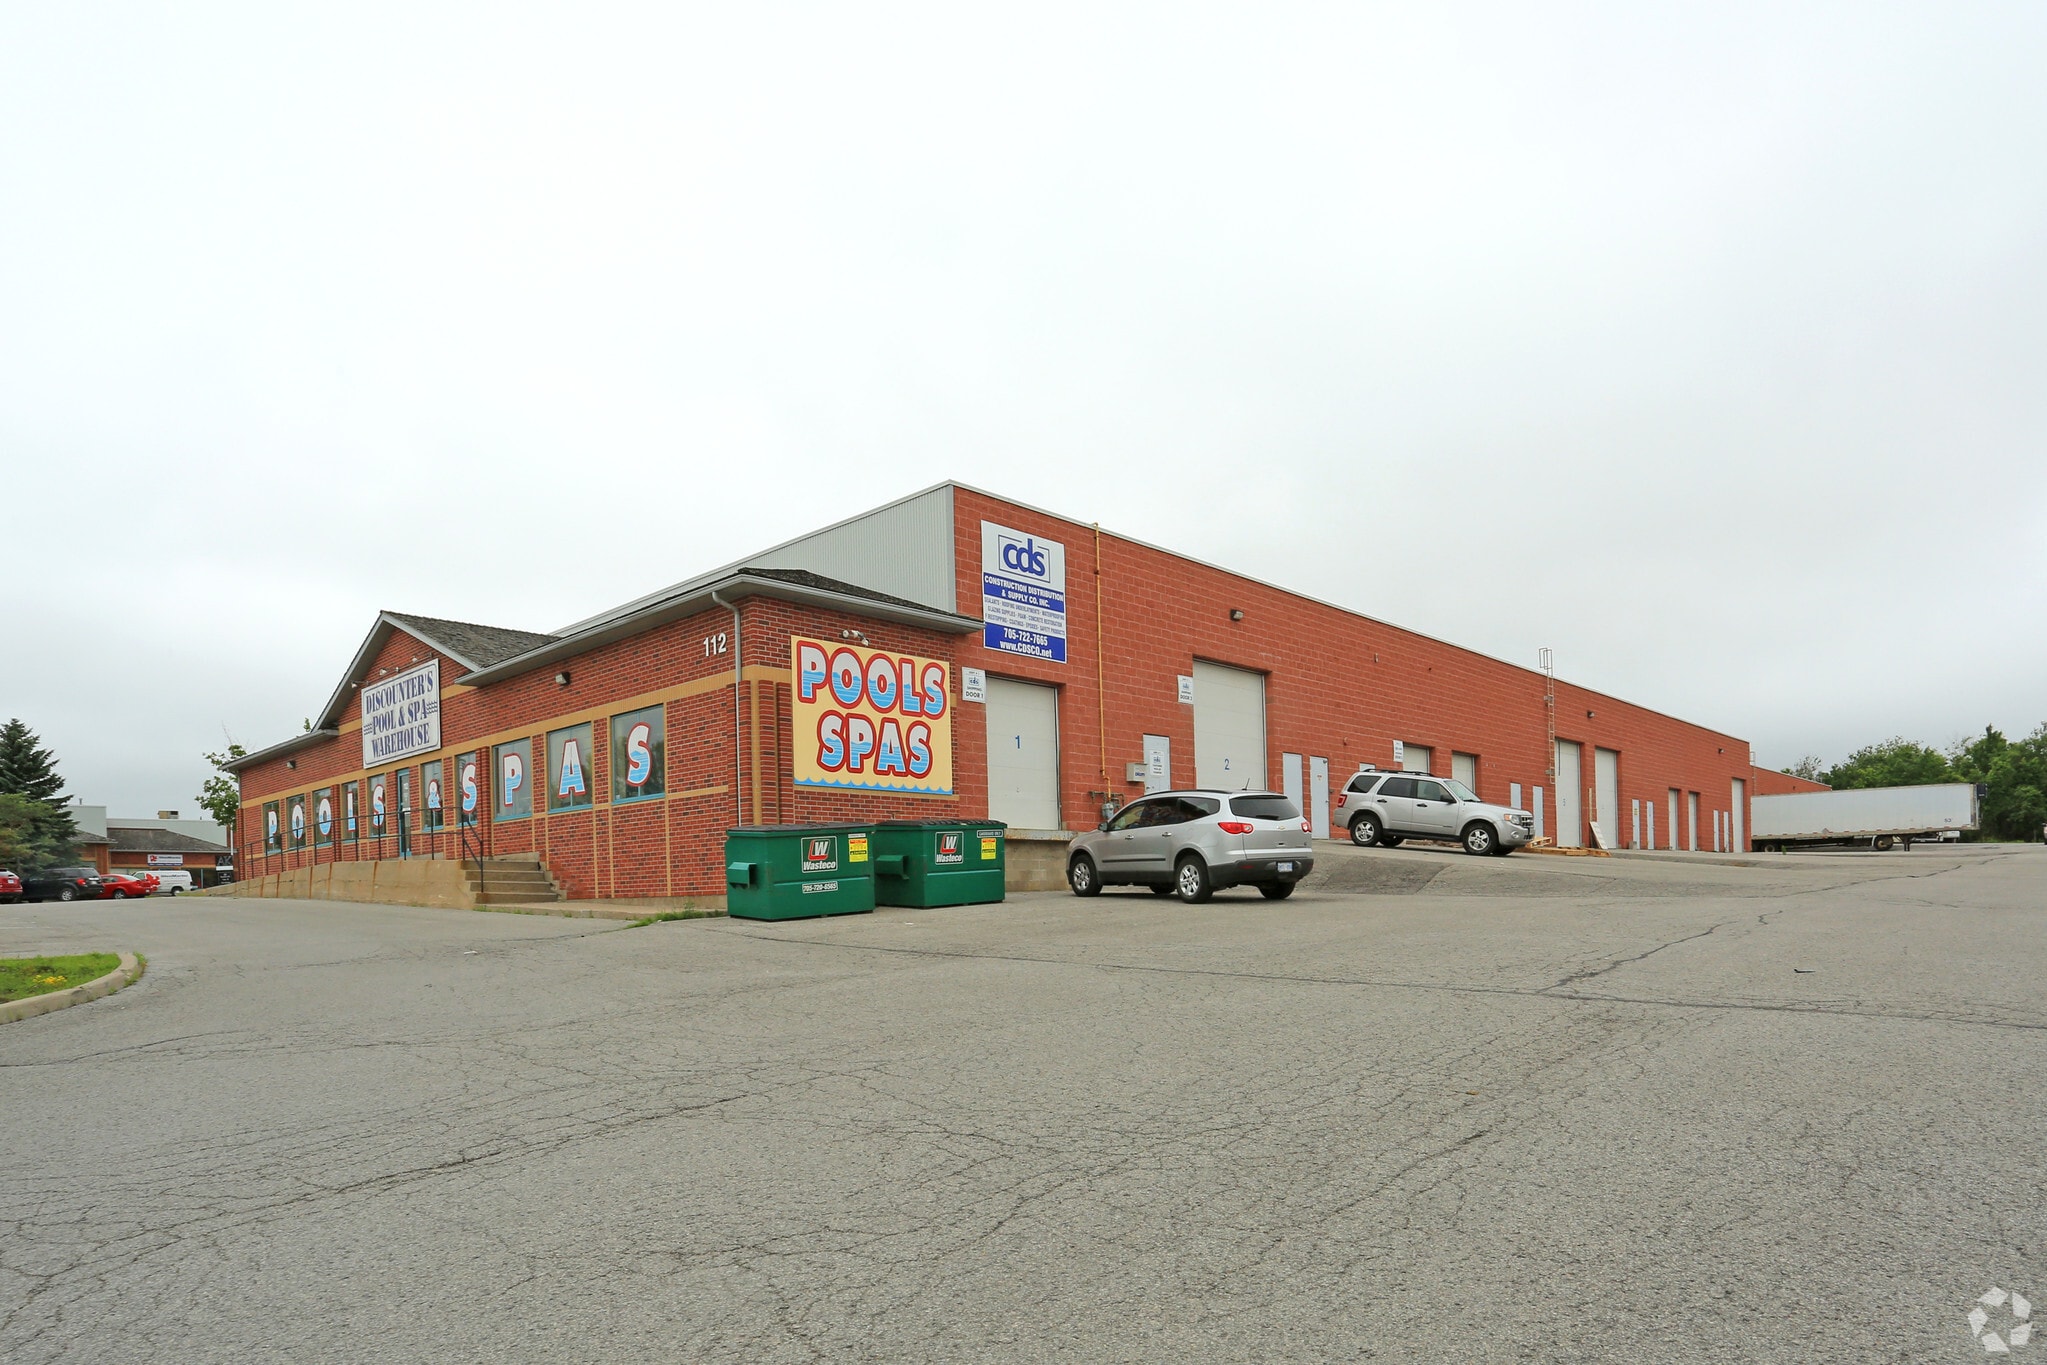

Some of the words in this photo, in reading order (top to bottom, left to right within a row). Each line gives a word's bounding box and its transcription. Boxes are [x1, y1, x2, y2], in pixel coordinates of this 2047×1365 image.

[1003, 538, 1045, 577] cds
[984, 575, 1028, 592] CONSTRUCTION
[1028, 585, 1064, 602] DISTRIBUTION
[1001, 589, 1007, 598] &
[1008, 591, 1029, 603] SUPPLY
[1029, 596, 1039, 605] CO.
[703, 632, 727, 657] 112
[1000, 640, 1052, 658] www.CDSCO.net
[1003, 628, 1048, 646] 705-722-7665
[797, 640, 947, 720] POOLS
[366, 671, 433, 715] DISCOUNTER'S
[372, 709, 397, 736] POOL
[398, 705, 406, 727] &
[407, 698, 428, 724] SPA
[371, 722, 430, 759] WAREHOUSE
[817, 710, 933, 779] SPAS
[1015, 735, 1021, 749] 1
[1224, 758, 1230, 770] 2
[803, 861, 836, 871] Wasteco
[937, 853, 962, 863] Wasteco
